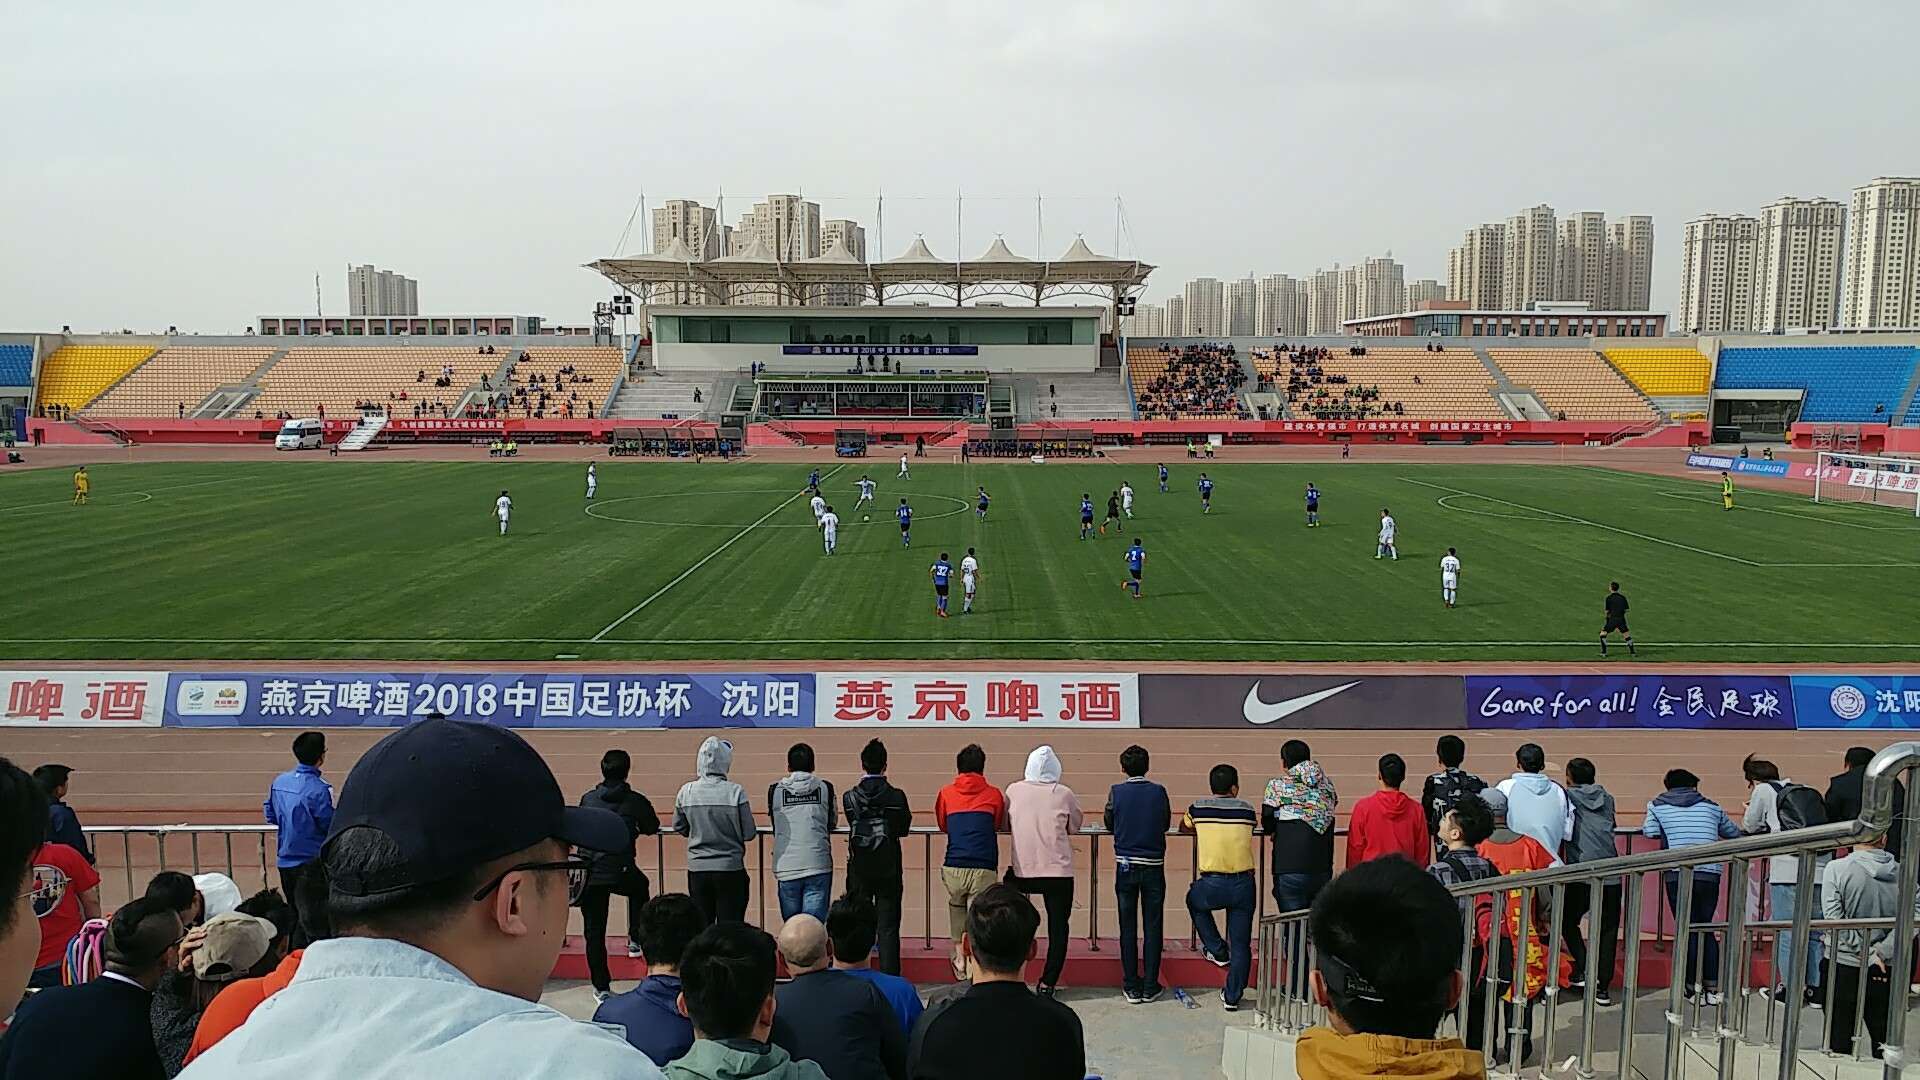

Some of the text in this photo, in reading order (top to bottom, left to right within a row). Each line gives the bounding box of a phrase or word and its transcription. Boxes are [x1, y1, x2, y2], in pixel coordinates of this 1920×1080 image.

[5, 679, 148, 721] 啤酒
[260, 680, 800, 717] 燕京啤酒2018中国足协杯 沈阳
[834, 680, 1121, 722] 燕京啤酒
[1480, 686, 1783, 719] Game for all! 全民足球
